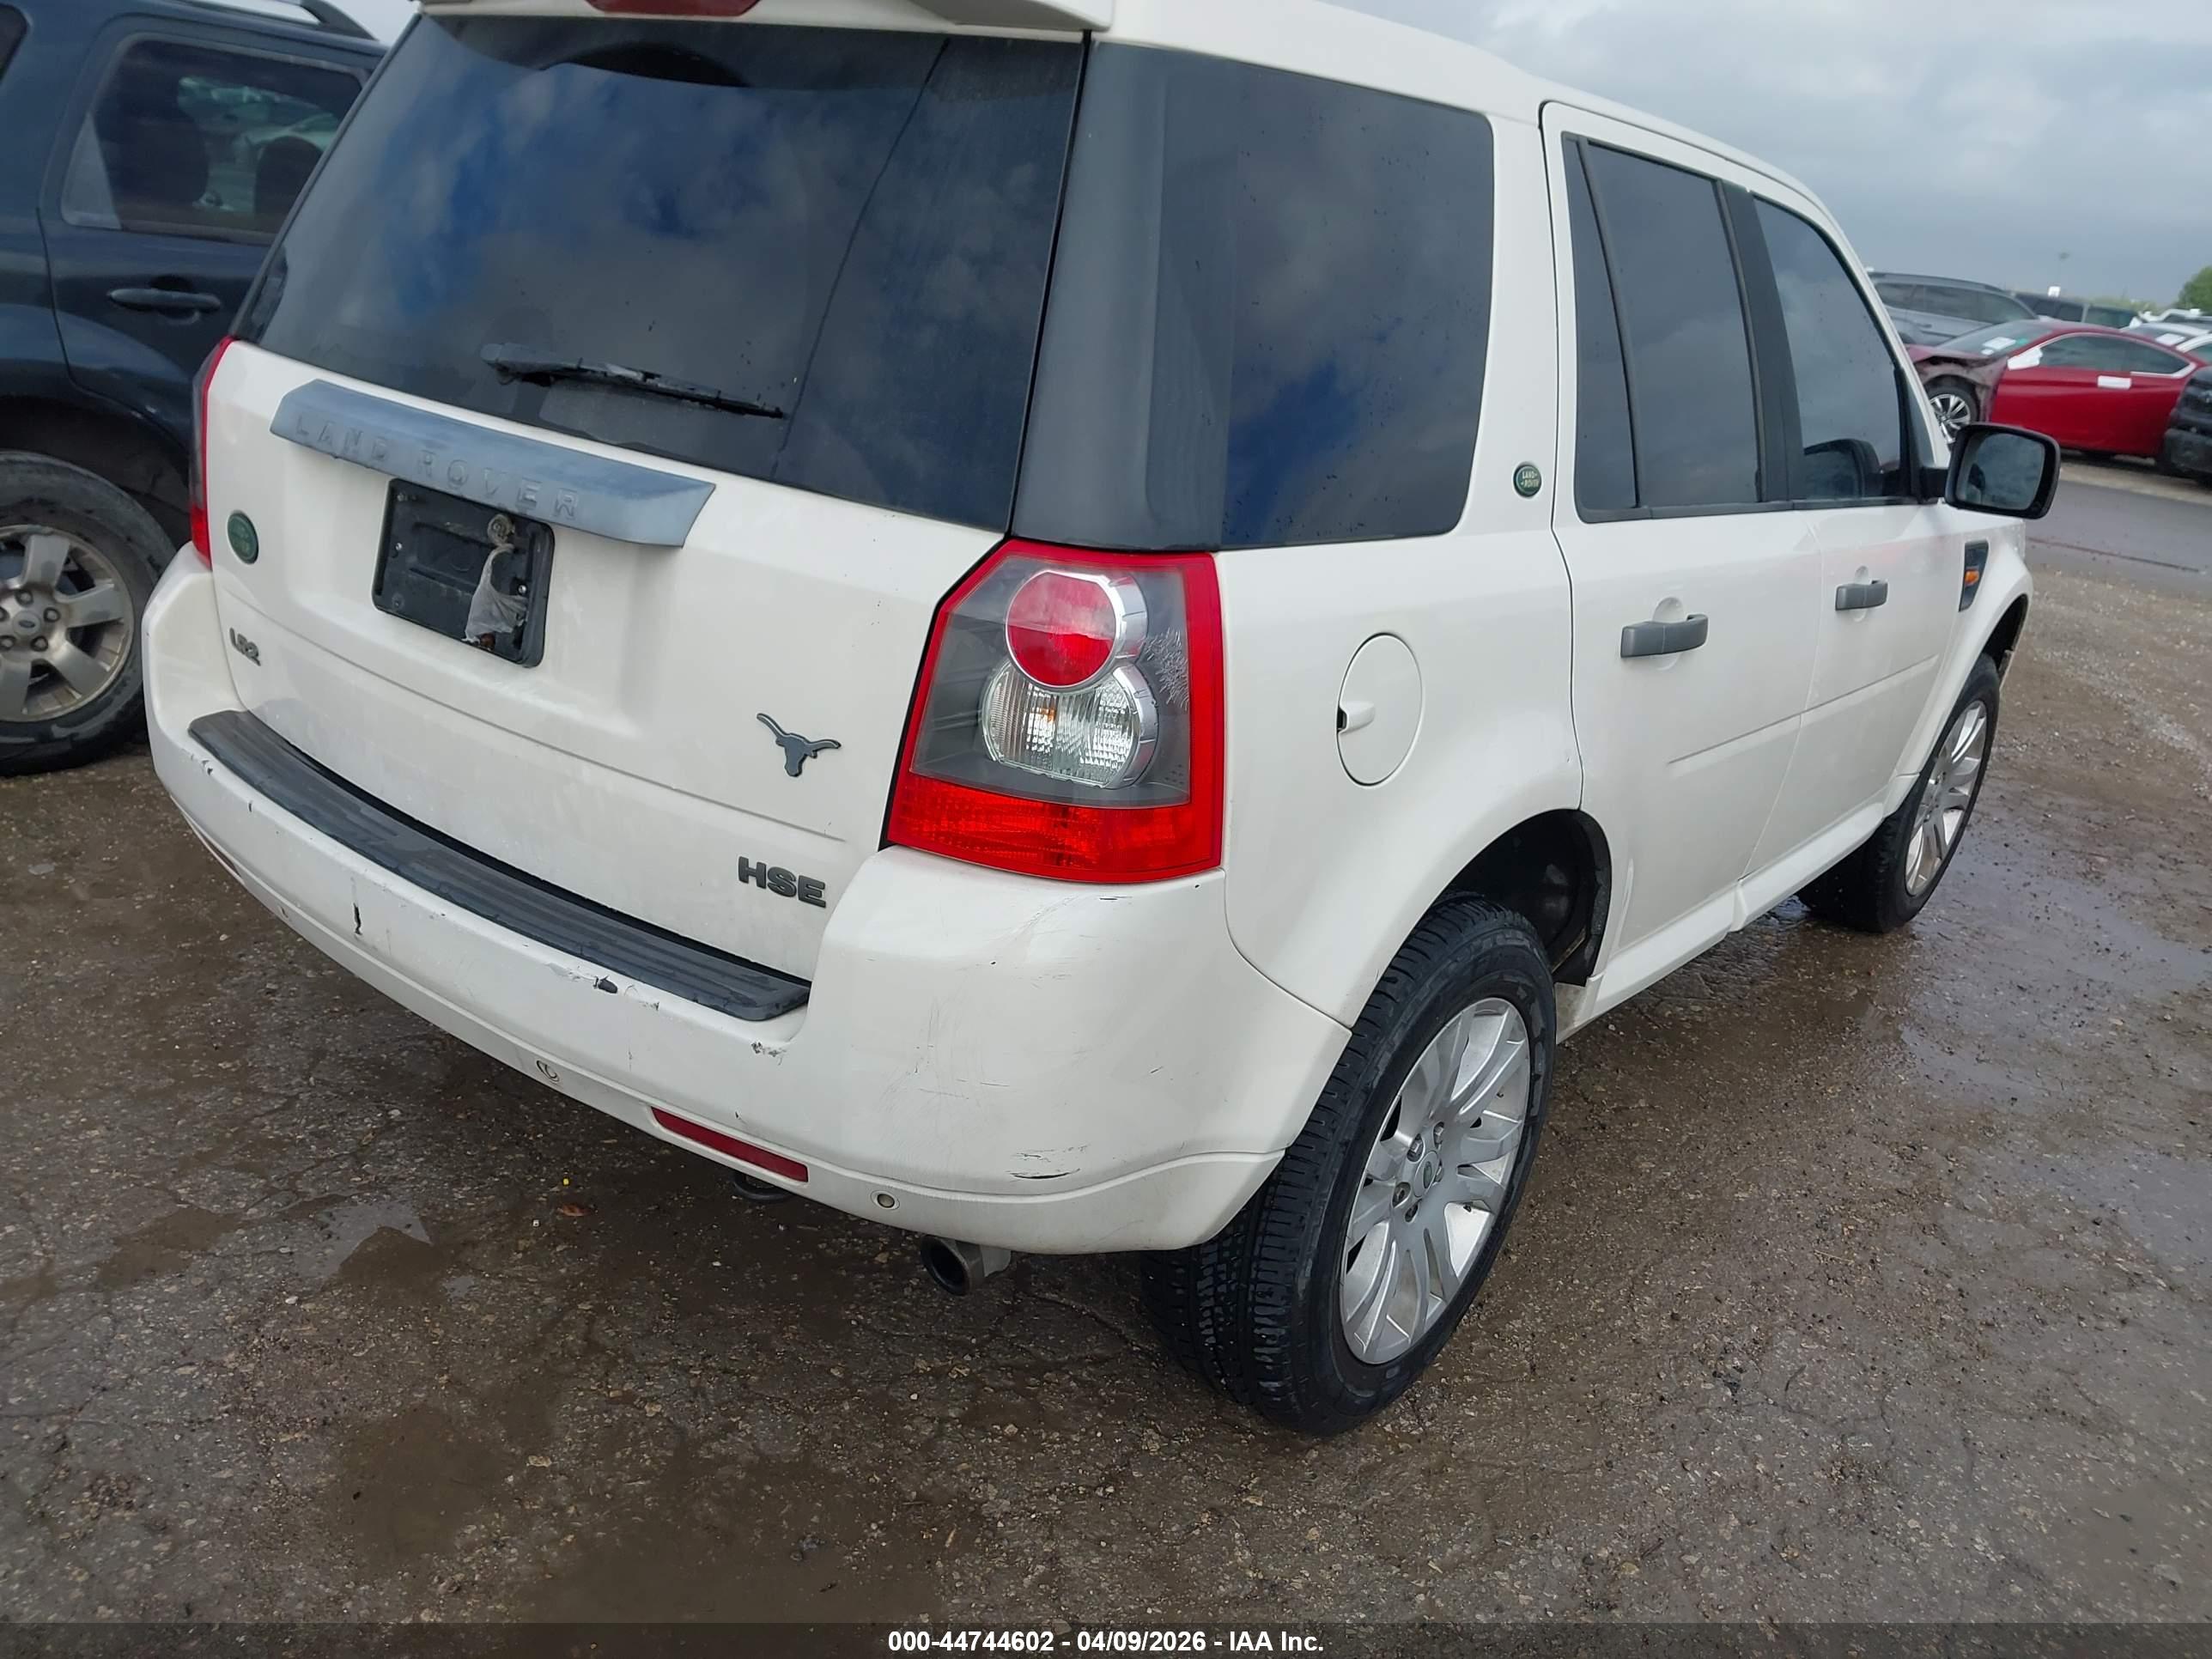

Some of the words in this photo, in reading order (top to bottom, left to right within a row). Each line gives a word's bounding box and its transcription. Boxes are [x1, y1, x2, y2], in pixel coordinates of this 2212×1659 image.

[295, 412, 391, 461] LAND
[417, 449, 580, 519] ROVER
[229, 627, 261, 666] LR2
[738, 855, 826, 908] HSE
